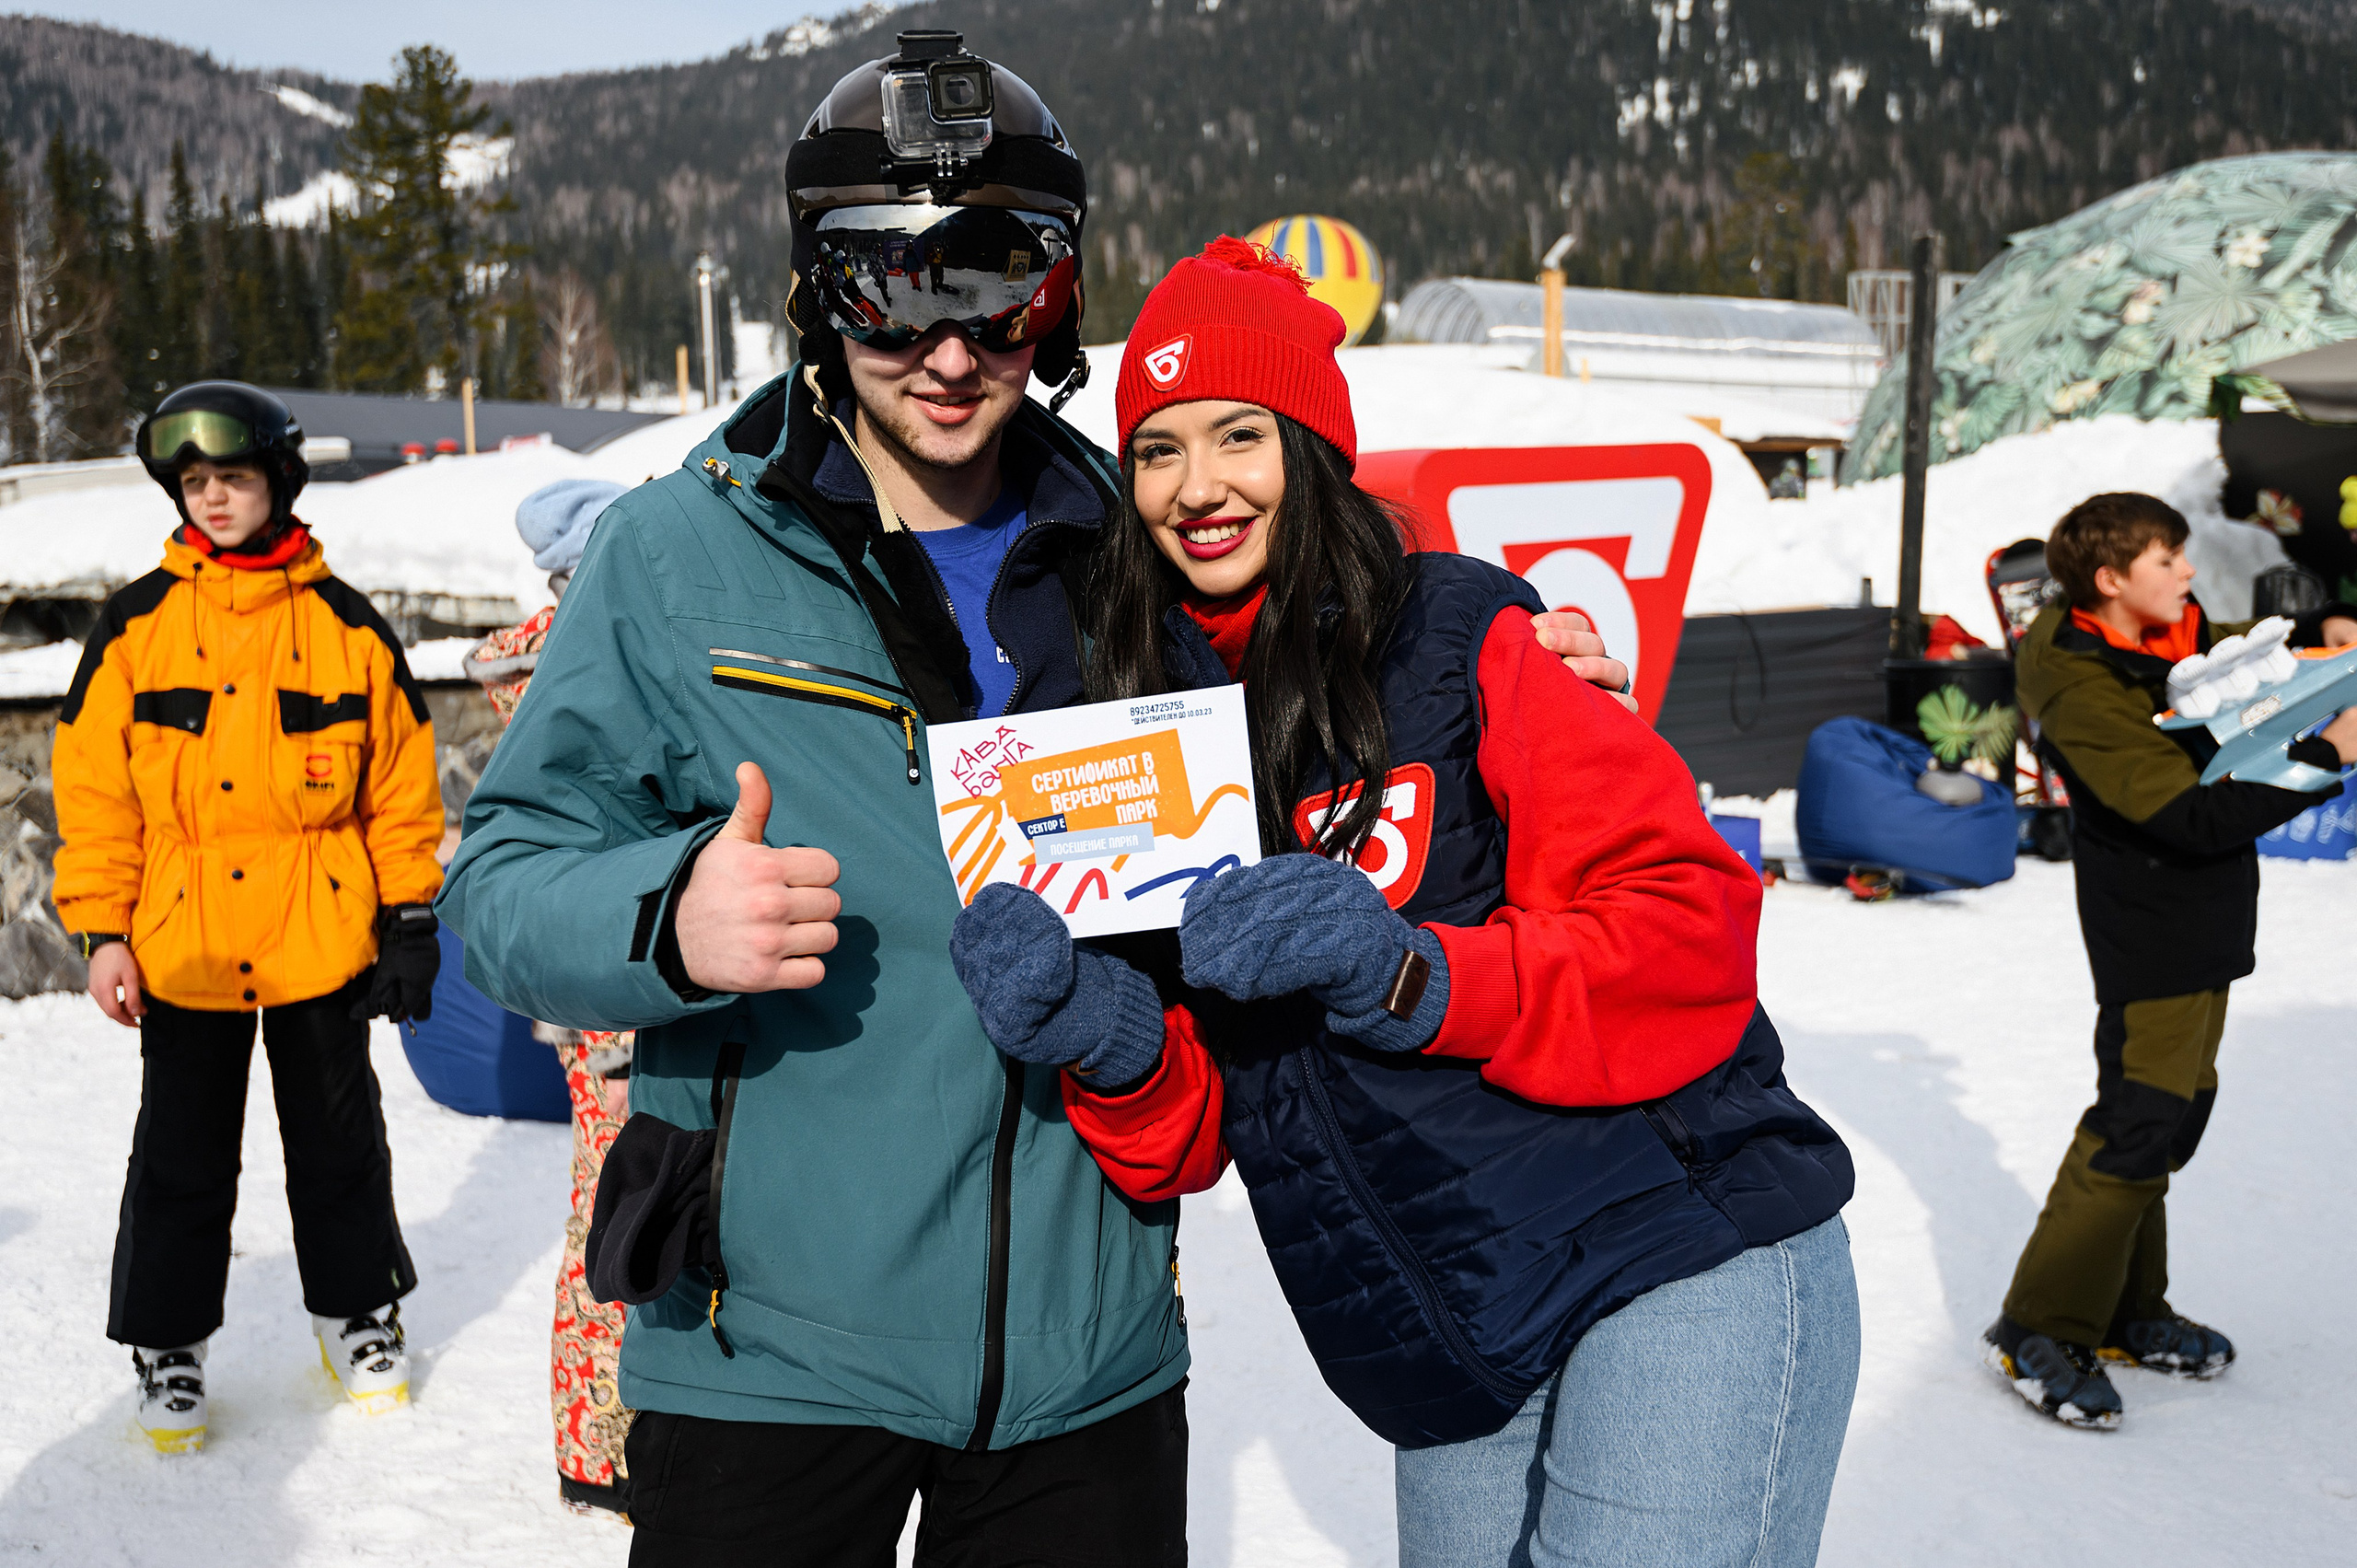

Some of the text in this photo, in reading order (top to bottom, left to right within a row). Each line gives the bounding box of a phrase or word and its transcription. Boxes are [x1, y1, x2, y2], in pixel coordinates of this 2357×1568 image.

[1130, 700, 1185, 716] 89234725755
[1178, 711, 1187, 719] ДО
[1187, 707, 1213, 718] 10.03.23
[950, 725, 1017, 781] КАВА
[1031, 751, 1155, 794] СЕРТИФИКАТ В
[1050, 770, 1160, 814] ВЕРЕВОЧНЫЙ
[1115, 797, 1158, 825] ПАРК
[1027, 818, 1066, 835] СЕКТОР Е
[1050, 834, 1139, 856] ПОСЕЩЕНИЕ ПАРКА
